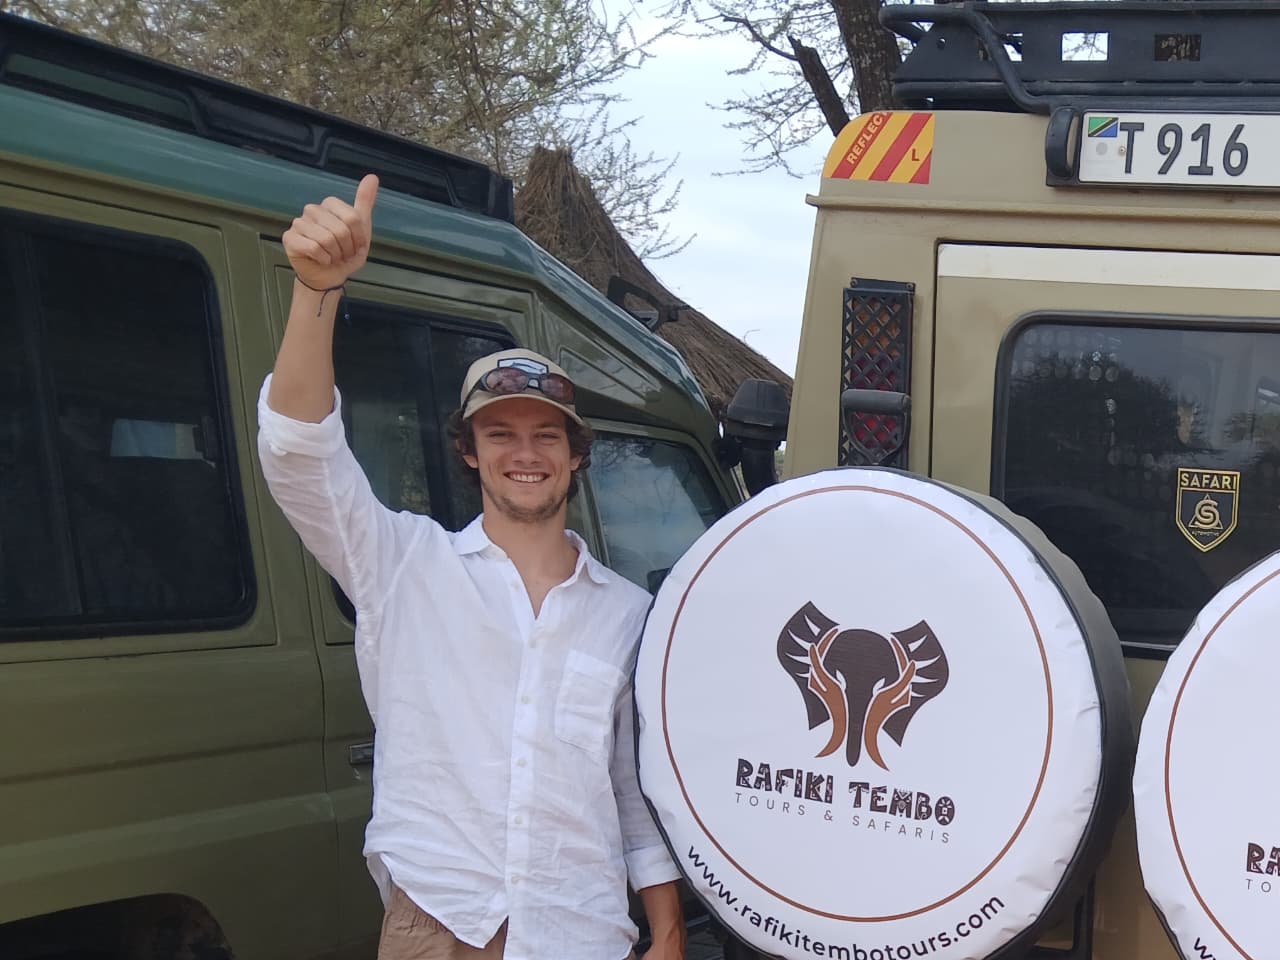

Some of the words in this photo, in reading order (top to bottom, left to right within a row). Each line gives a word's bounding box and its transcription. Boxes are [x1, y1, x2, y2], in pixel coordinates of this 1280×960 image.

[1120, 122, 1144, 174] T
[1154, 122, 1249, 177] 916
[1180, 472, 1237, 490] SAFARI
[735, 758, 834, 805] RAFIKI
[848, 781, 956, 826] TEMBO
[735, 792, 806, 817] TOURS
[823, 809, 833, 822] &
[851, 815, 950, 844] SAFARIS
